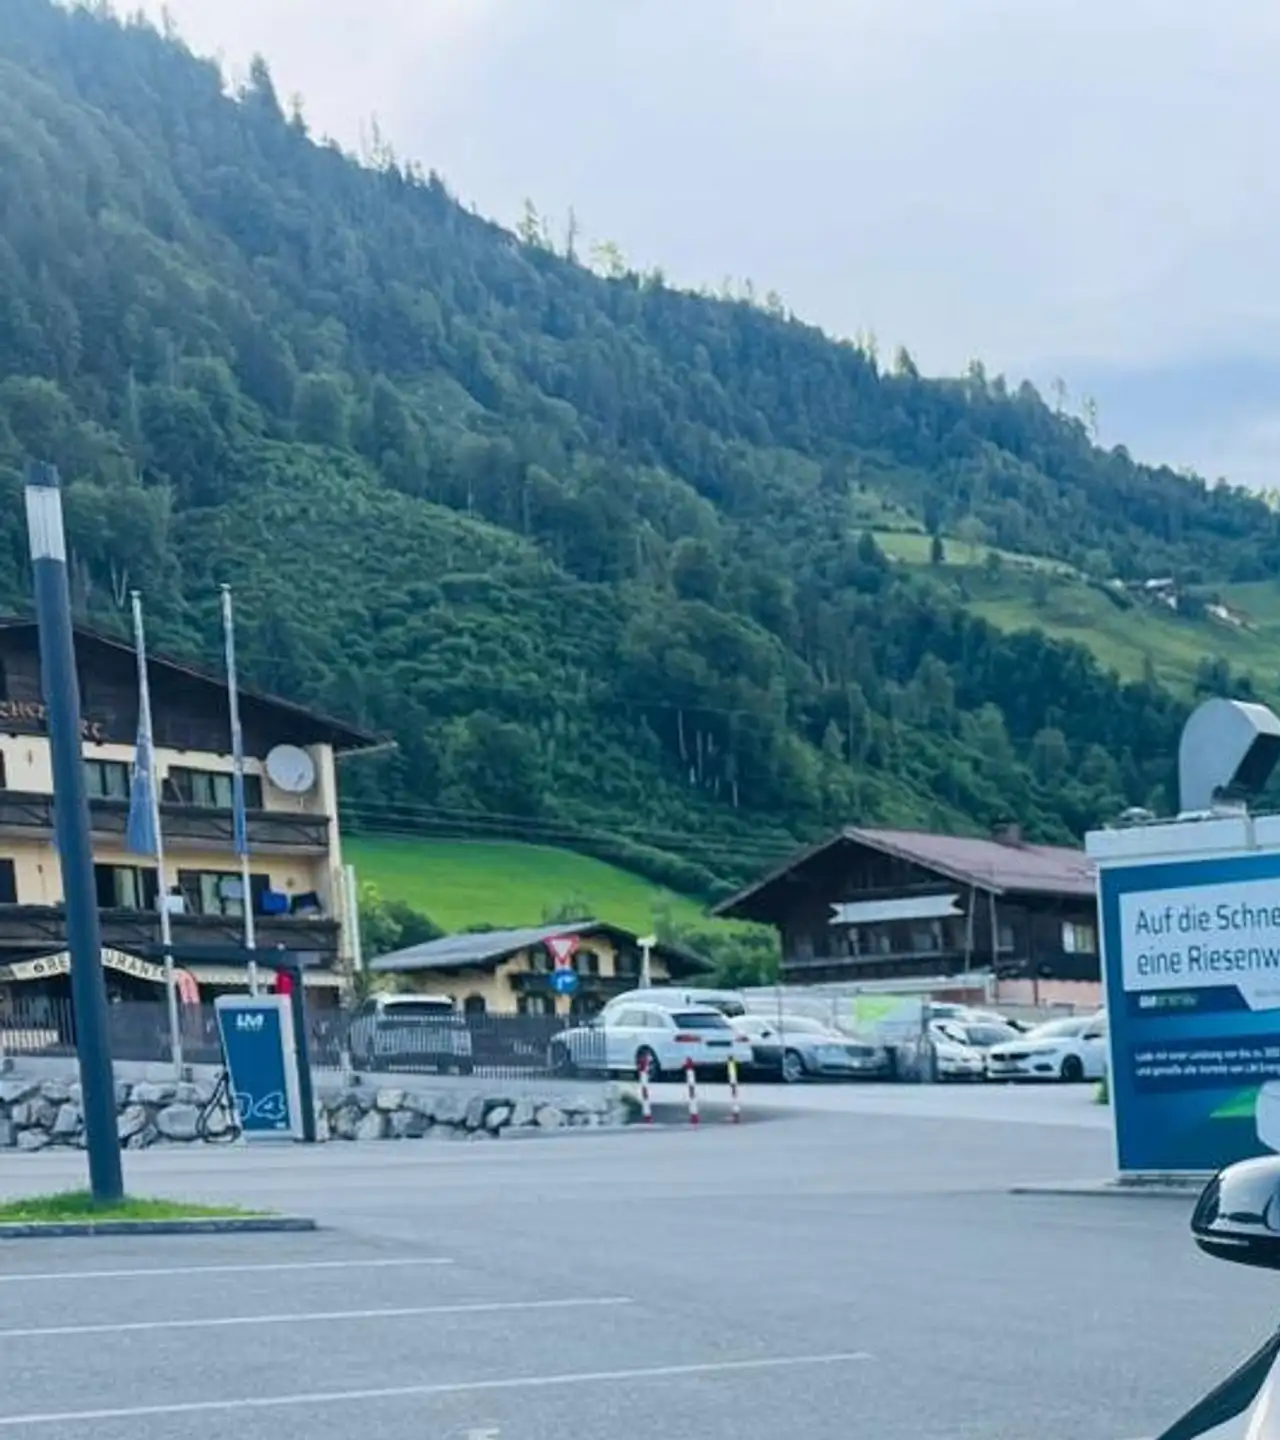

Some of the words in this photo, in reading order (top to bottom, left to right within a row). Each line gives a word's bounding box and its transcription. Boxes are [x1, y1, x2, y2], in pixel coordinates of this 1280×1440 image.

[1135, 907, 1173, 936] Auf
[1178, 906, 1211, 933] die
[1137, 945, 1182, 976] eine
